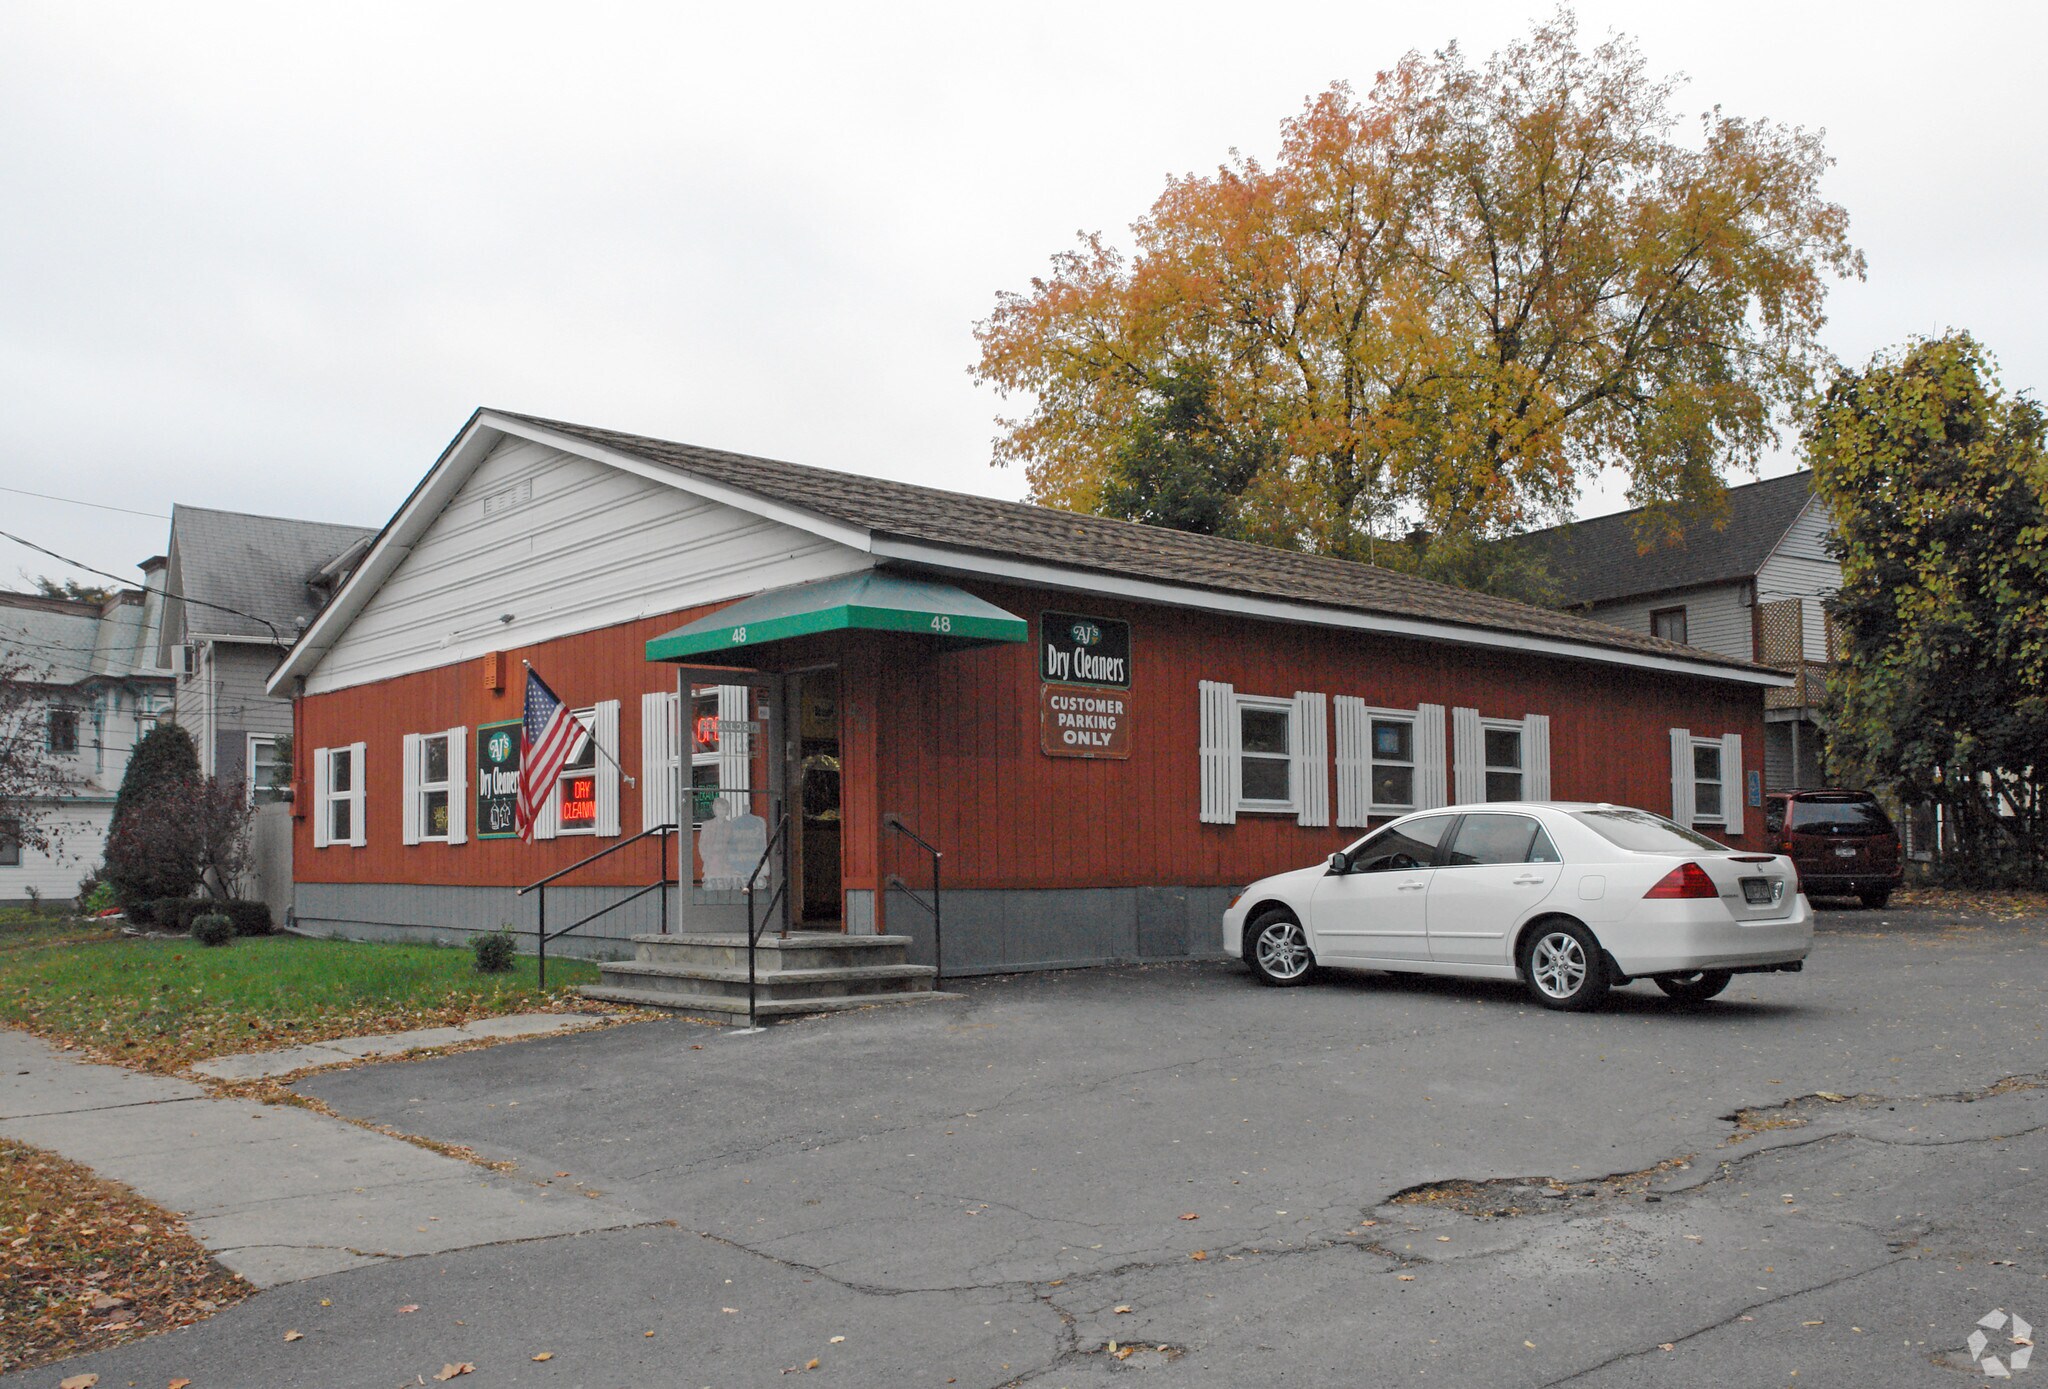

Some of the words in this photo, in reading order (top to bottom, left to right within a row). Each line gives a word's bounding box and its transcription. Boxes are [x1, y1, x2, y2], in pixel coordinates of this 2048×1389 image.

[931, 616, 951, 632] 48
[732, 627, 747, 643] 48
[1073, 624, 1099, 645] AJ's
[1048, 643, 1070, 681] Dry
[1073, 647, 1124, 682] Cleaners
[1050, 695, 1124, 715] CUSTOMER
[1058, 713, 1117, 730] PARKING
[489, 734, 509, 761] AJ's
[1063, 730, 1112, 746] ONLY
[480, 768, 492, 799] Dry
[574, 781, 592, 799] DRY
